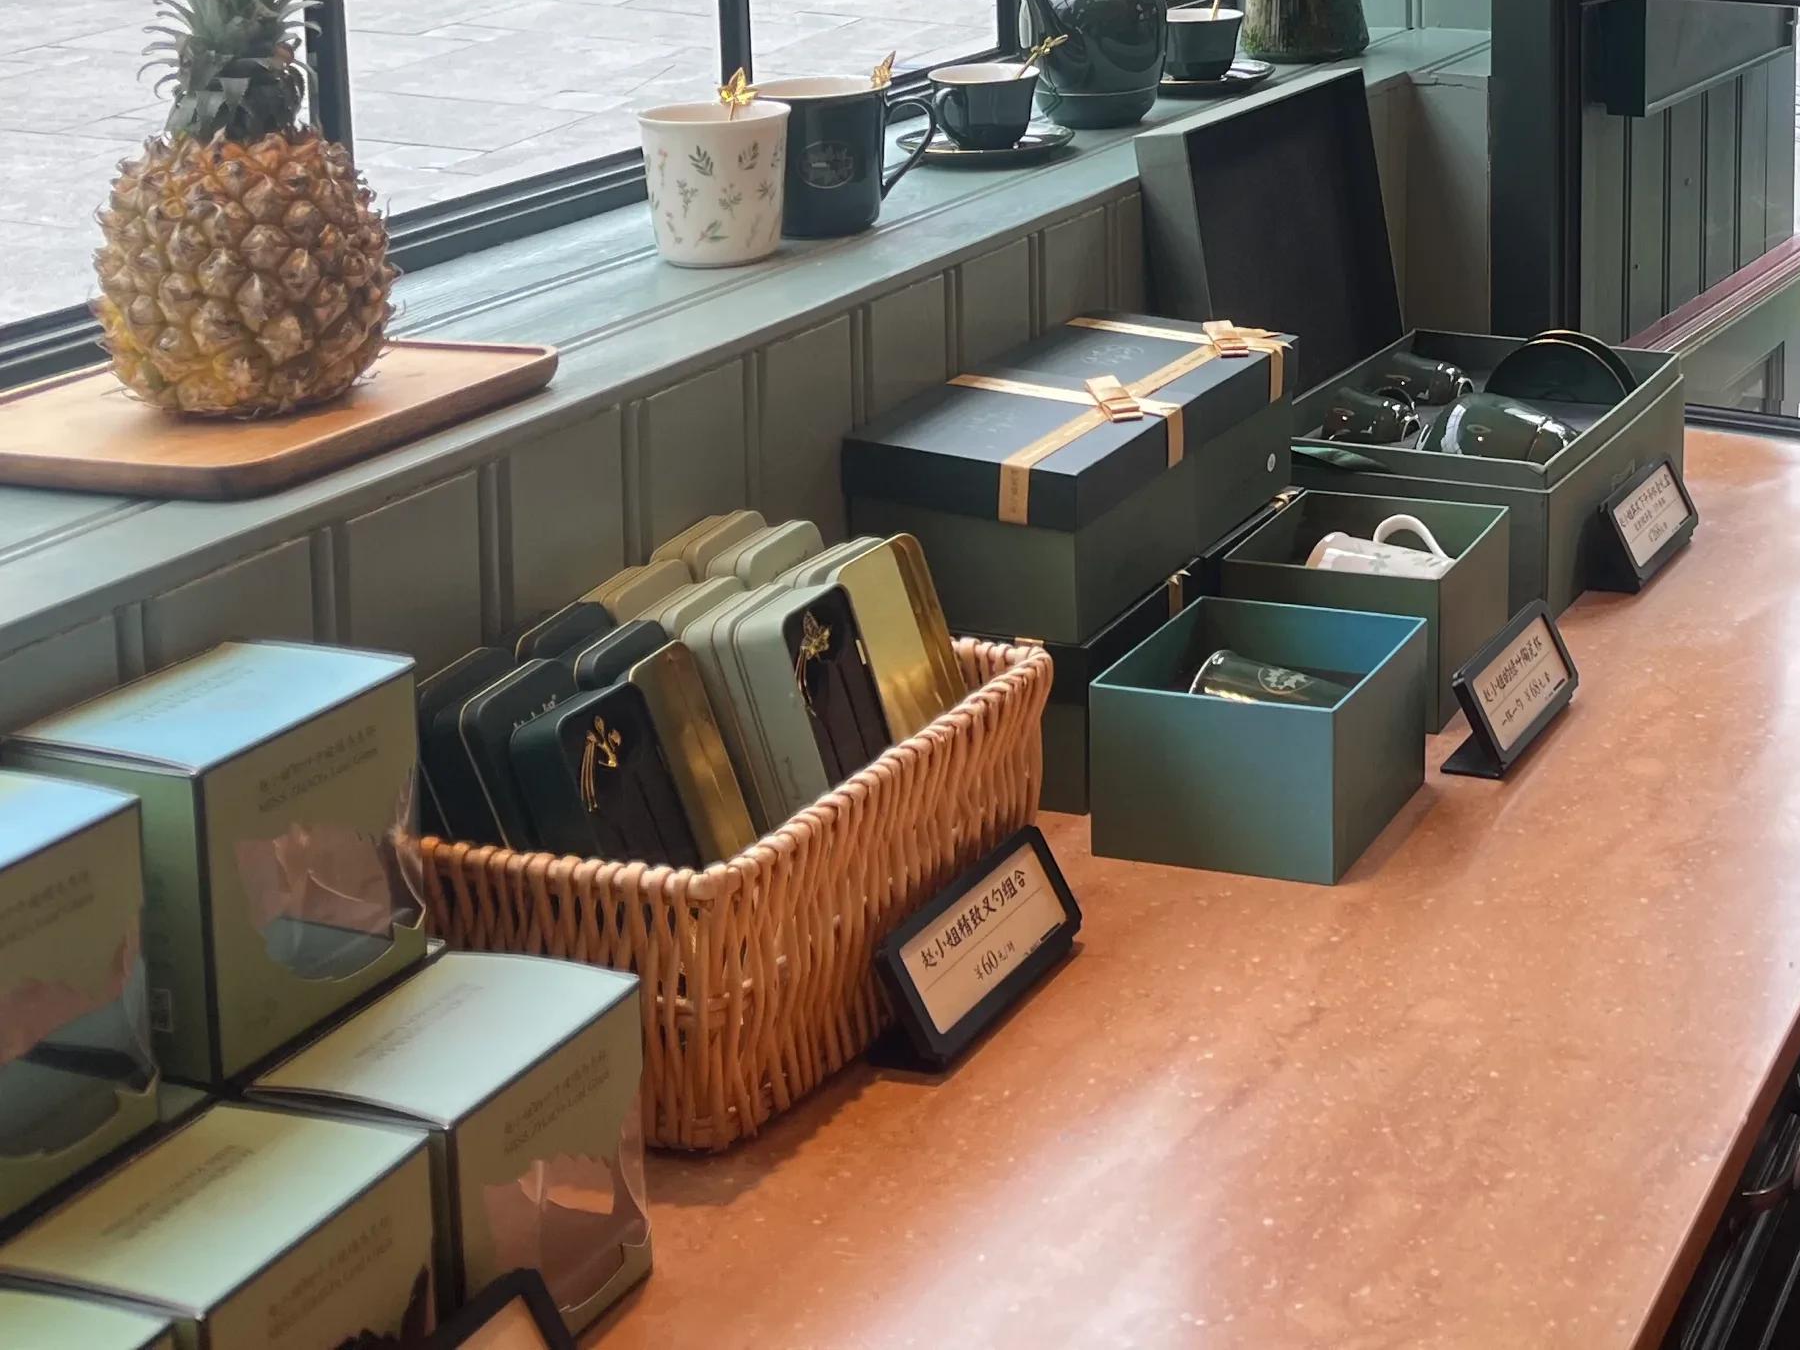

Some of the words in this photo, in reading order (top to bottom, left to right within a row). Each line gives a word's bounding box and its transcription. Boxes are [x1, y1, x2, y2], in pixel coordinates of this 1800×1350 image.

[920, 869, 1026, 970] 赵小姐精致叉勺组合
